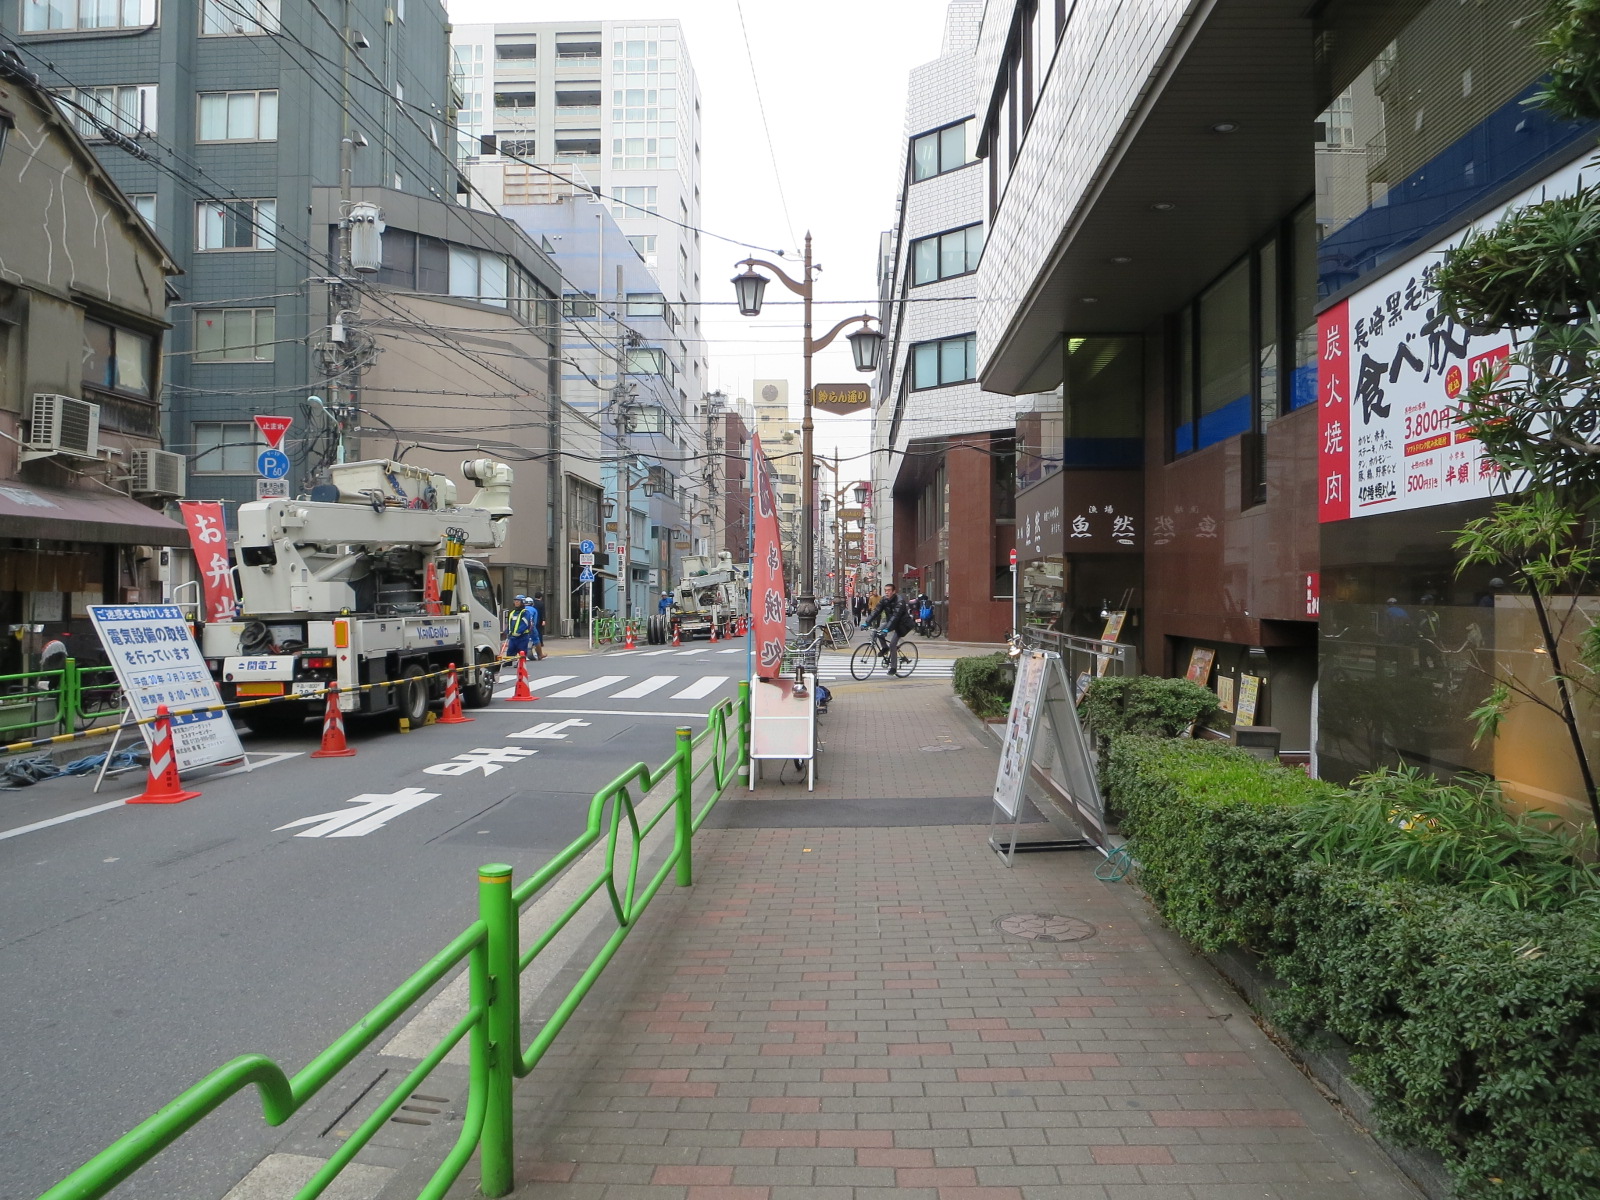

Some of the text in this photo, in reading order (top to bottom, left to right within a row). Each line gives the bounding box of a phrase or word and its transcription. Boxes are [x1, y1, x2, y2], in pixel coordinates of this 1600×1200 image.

[818, 390, 867, 403] 鈴らん通り
[1324, 325, 1343, 505] 炭火焼肉
[1404, 408, 1450, 440] 3,800円
[262, 422, 285, 430] 止まれ
[1449, 451, 1466, 460] 小学生
[264, 457, 277, 476] P
[1445, 462, 1470, 486] 半額
[1407, 474, 1438, 493] 500円引き
[1070, 514, 1136, 538] 魚然
[195, 514, 236, 621] お弁当
[96, 608, 179, 621] ご迷惑をおかけします
[107, 626, 189, 646] 電気設備の取替
[125, 647, 190, 665] を行っています
[246, 661, 278, 671] 関電工
[141, 693, 166, 706] 時間帯
[271, 718, 592, 838] 止まれ
